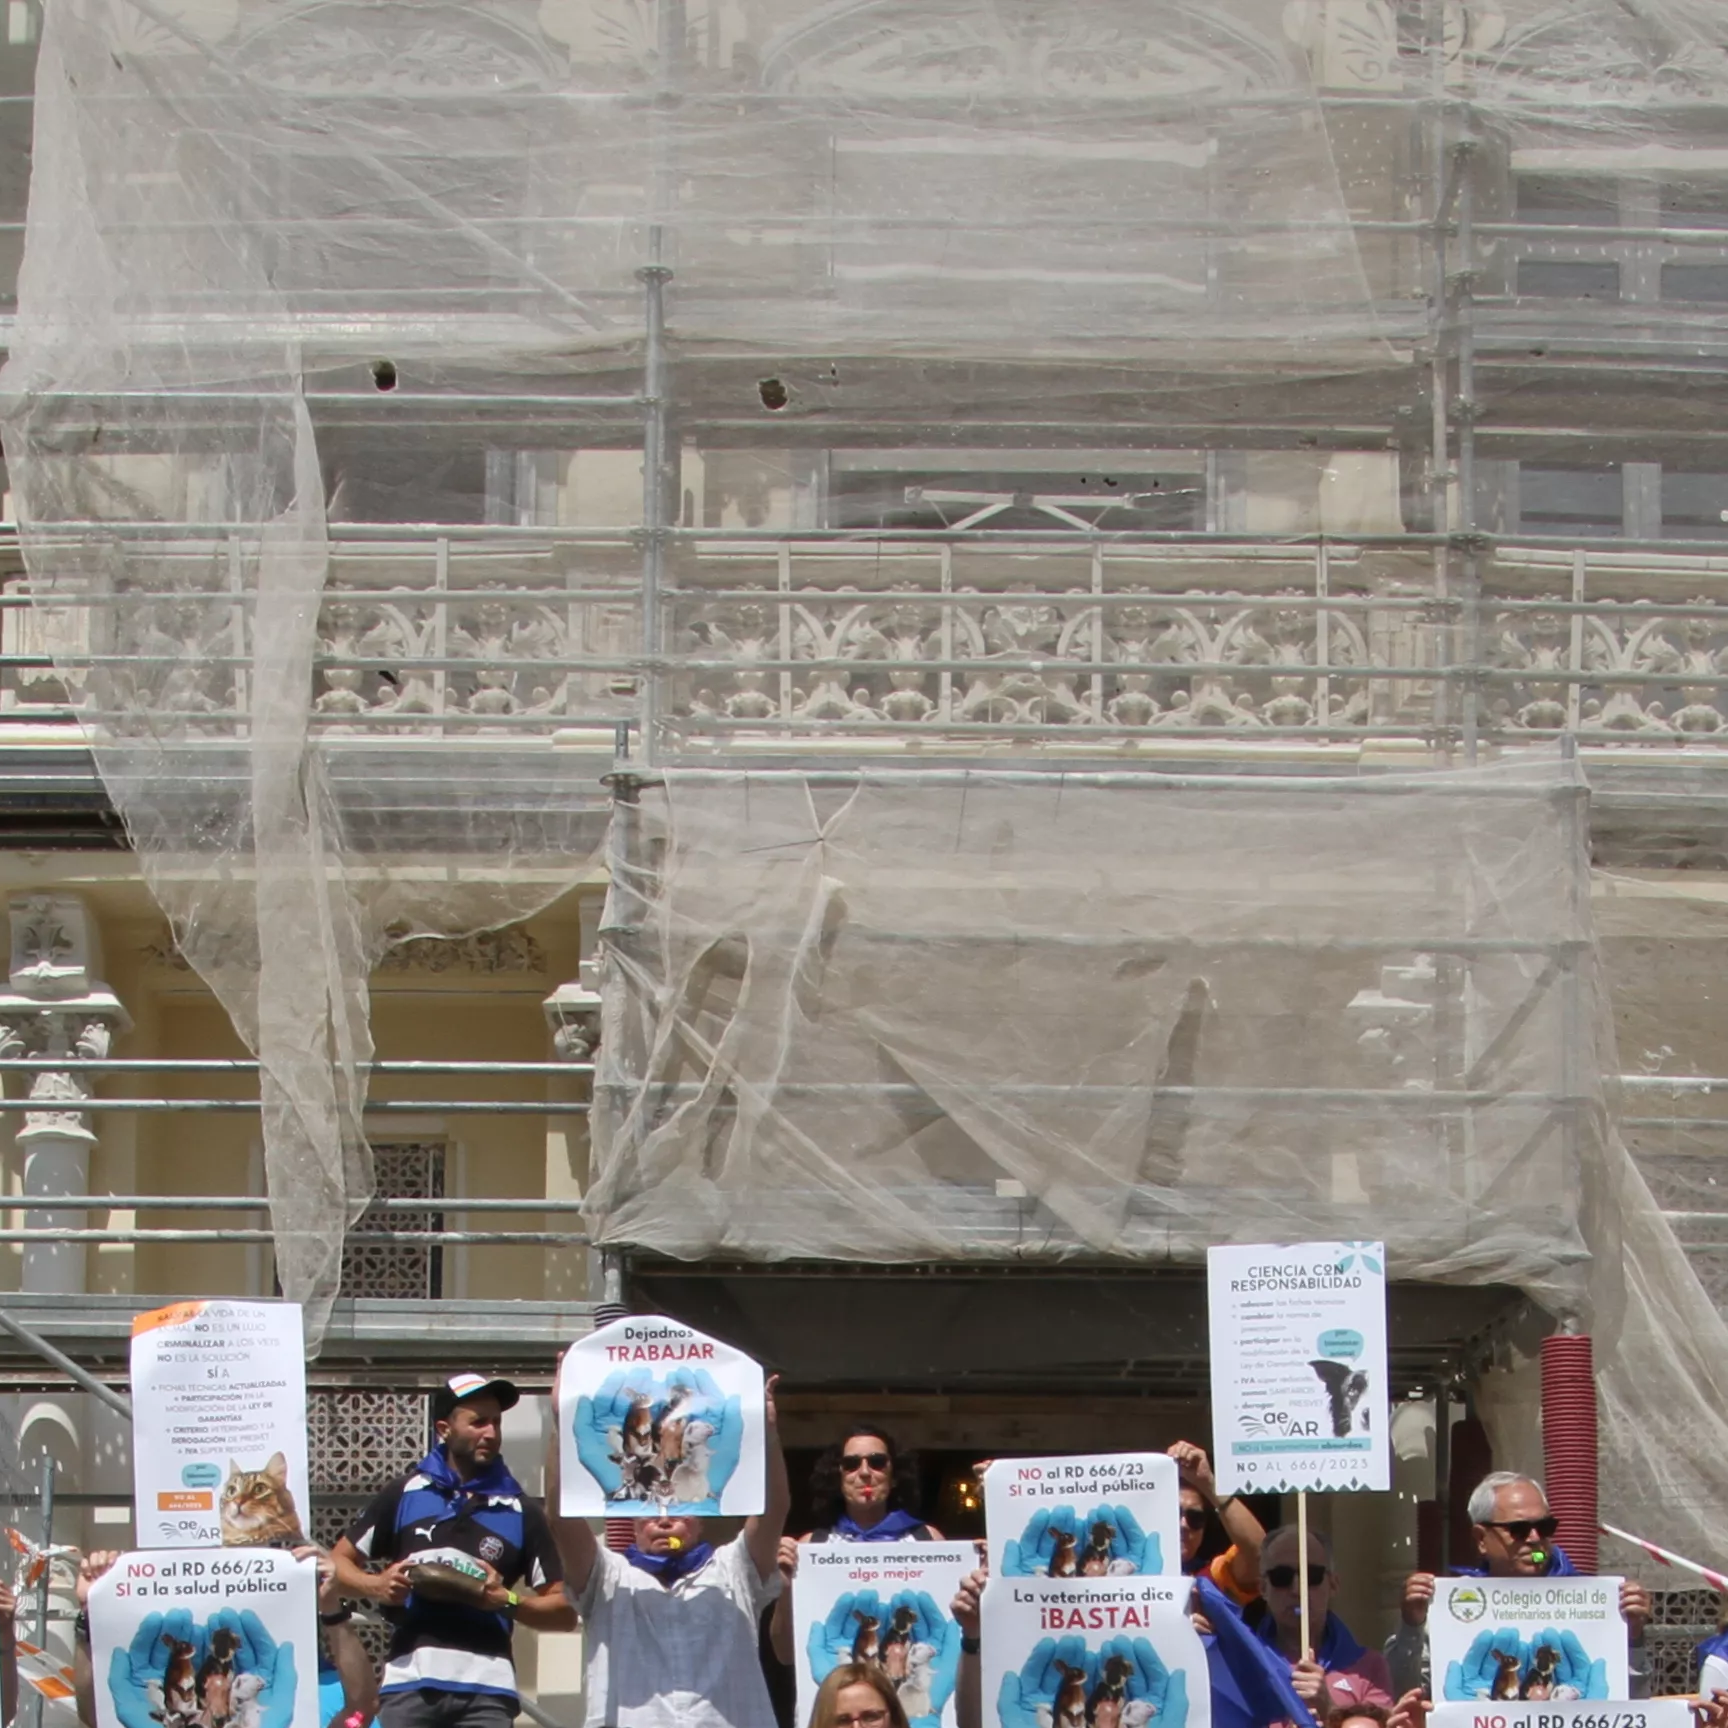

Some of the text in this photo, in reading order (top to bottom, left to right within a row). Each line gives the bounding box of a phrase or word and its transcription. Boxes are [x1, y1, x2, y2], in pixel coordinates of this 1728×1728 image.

[1248, 1265, 1306, 1278] CIENCIA
[1231, 1277, 1361, 1292] RESPONSABILIDAD
[195, 1324, 209, 1332] NO
[625, 1326, 693, 1342] Dejadnos
[606, 1343, 714, 1362] TRABAJAR
[207, 1366, 218, 1378] SÍ
[1018, 1463, 1144, 1480] NO al RD 666/23
[1237, 1458, 1368, 1473] NO AL 666/2023
[1009, 1484, 1022, 1496] SI
[1041, 1483, 1054, 1495] la
[1059, 1480, 1097, 1494] salud
[1102, 1479, 1155, 1495] pública
[810, 1553, 961, 1565] Todos nos merecemos
[127, 1560, 275, 1578] NO al RD 666/23
[848, 1567, 924, 1582] algo mejor
[116, 1578, 287, 1597] SI a la salud pública
[1014, 1587, 1173, 1603] La veterinaria dice
[1492, 1589, 1607, 1609] Colegio Oficial de
[1041, 1605, 1150, 1630] ¡BASTA!
[1492, 1609, 1605, 1620] Veterinarios de Huesca
